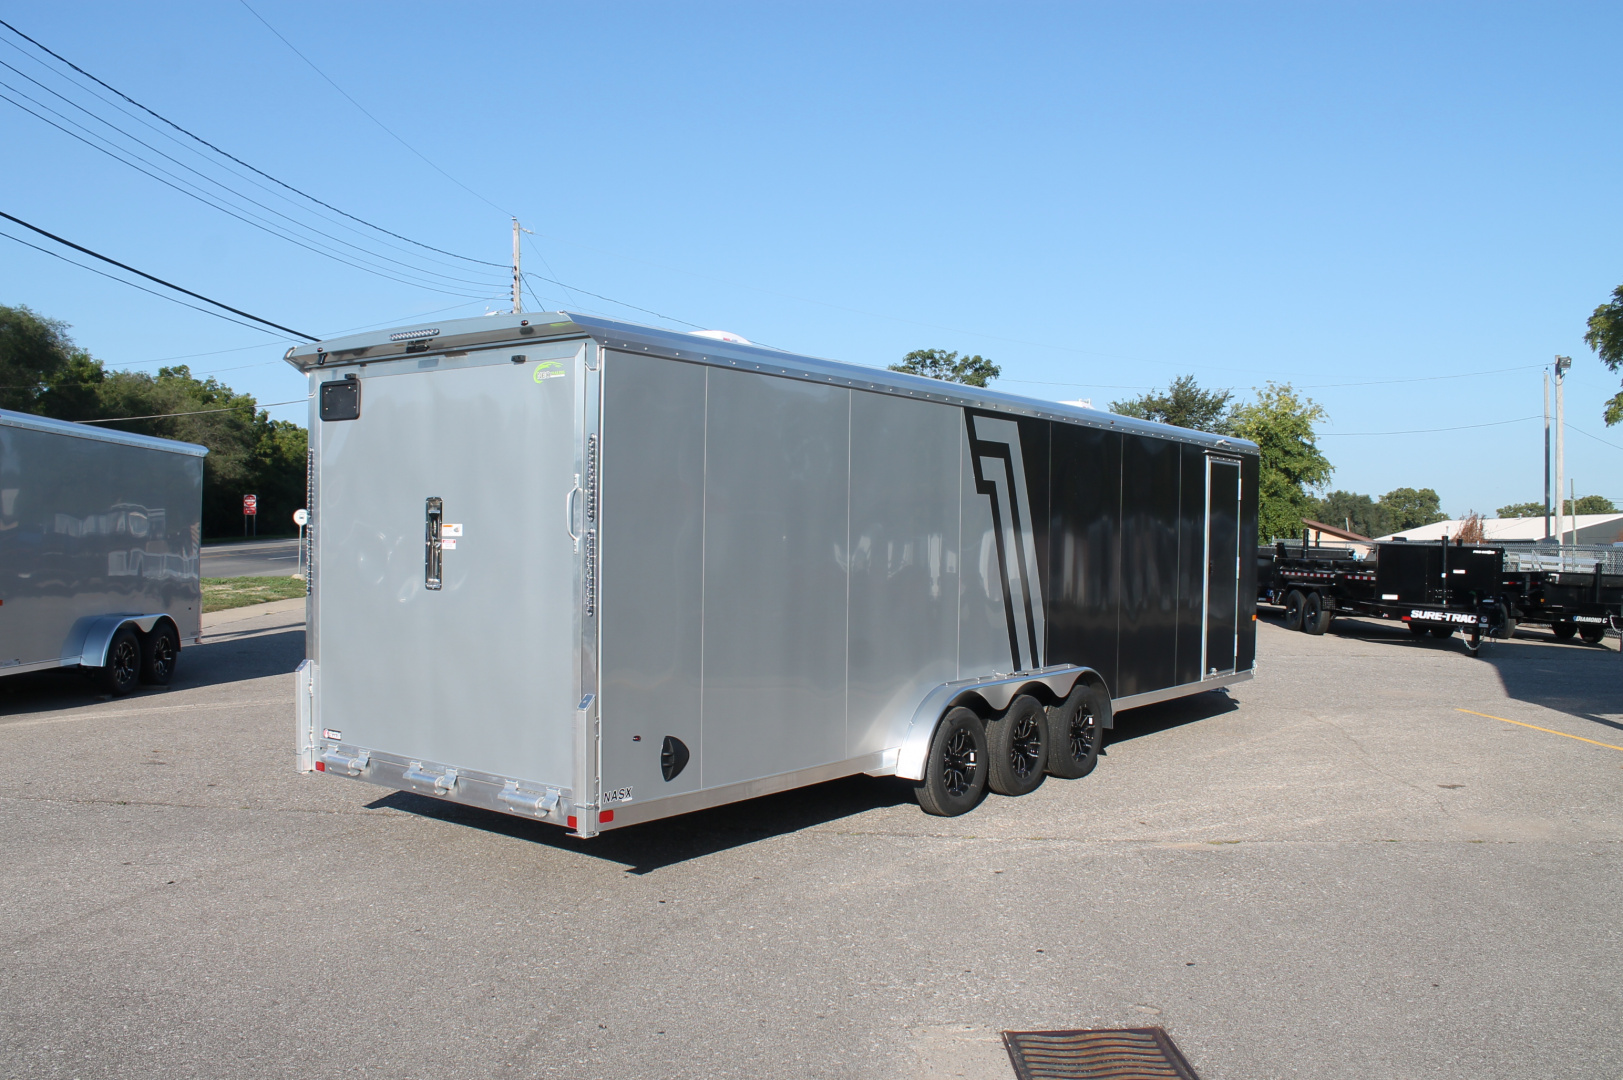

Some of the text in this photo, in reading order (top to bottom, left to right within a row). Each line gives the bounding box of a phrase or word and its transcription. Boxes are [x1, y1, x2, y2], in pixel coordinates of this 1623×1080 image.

[1410, 609, 1477, 624] SURE-TRAC
[1575, 615, 1602, 624] DIAMOND
[603, 786, 633, 804] NASX
